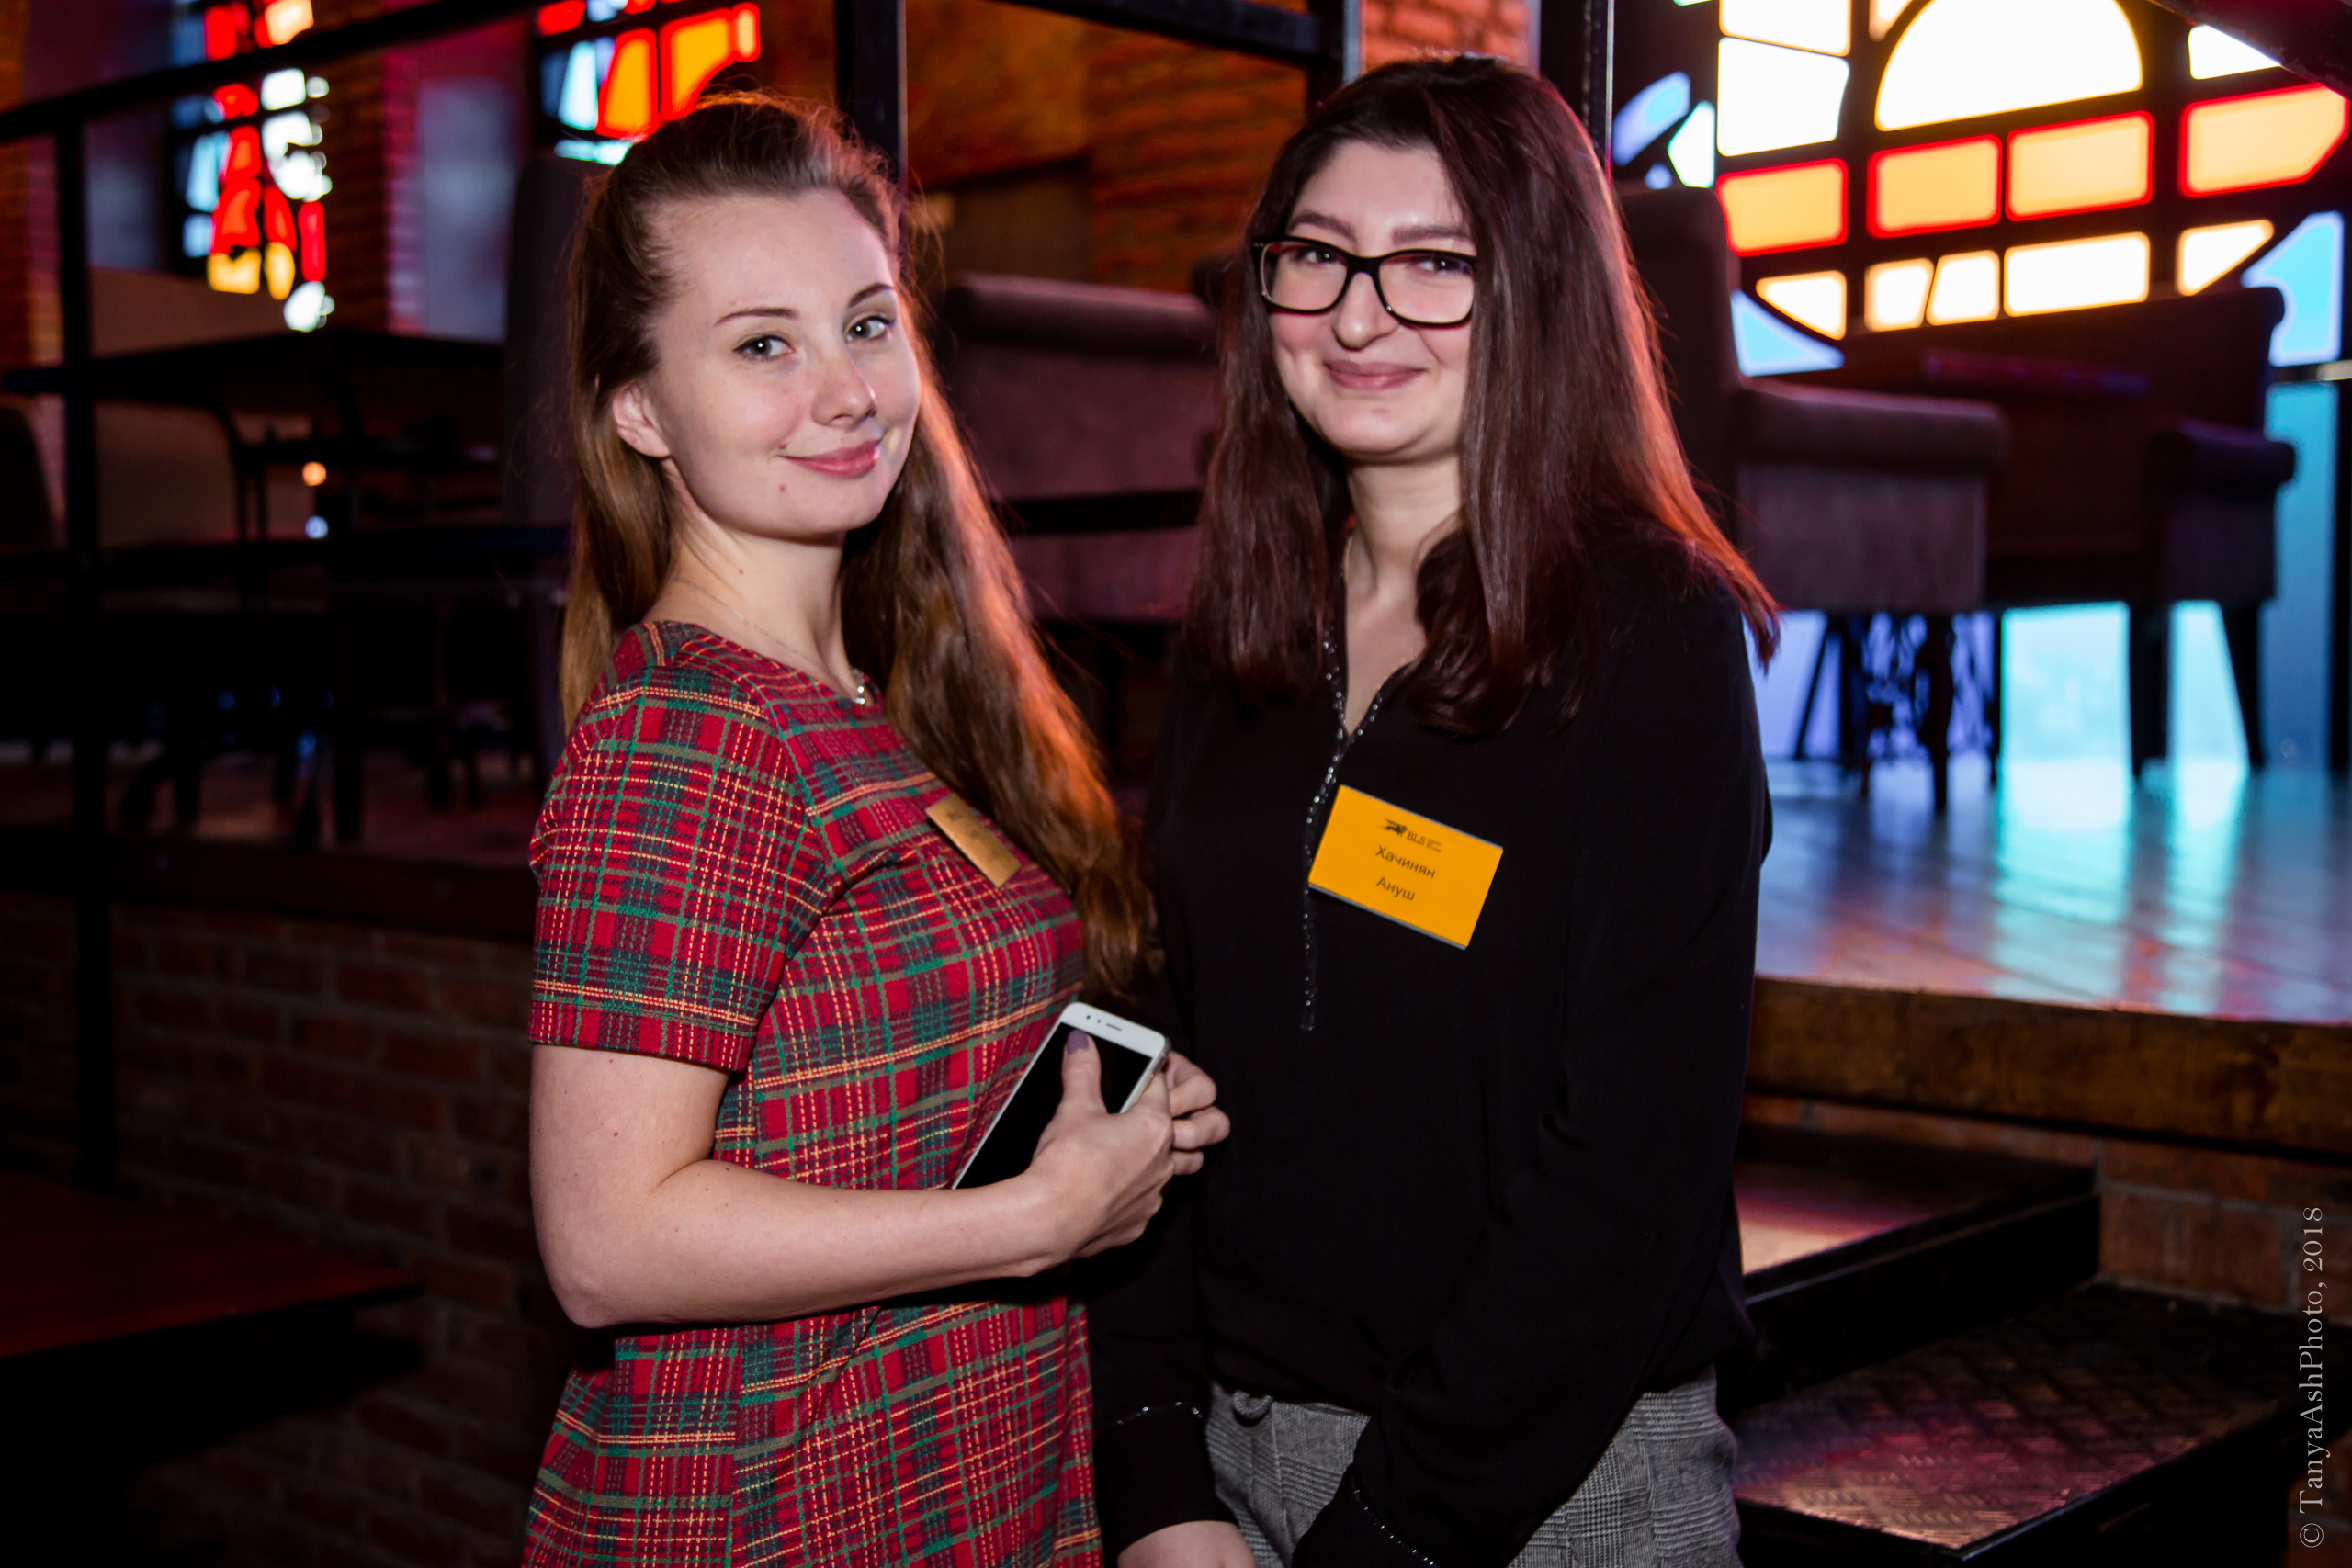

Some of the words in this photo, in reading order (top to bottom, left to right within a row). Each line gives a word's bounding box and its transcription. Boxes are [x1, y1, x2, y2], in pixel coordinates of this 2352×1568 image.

[1407, 831, 1426, 845] BLS
[1375, 844, 1435, 878] Хачинян
[1376, 876, 1415, 900] Ануш
